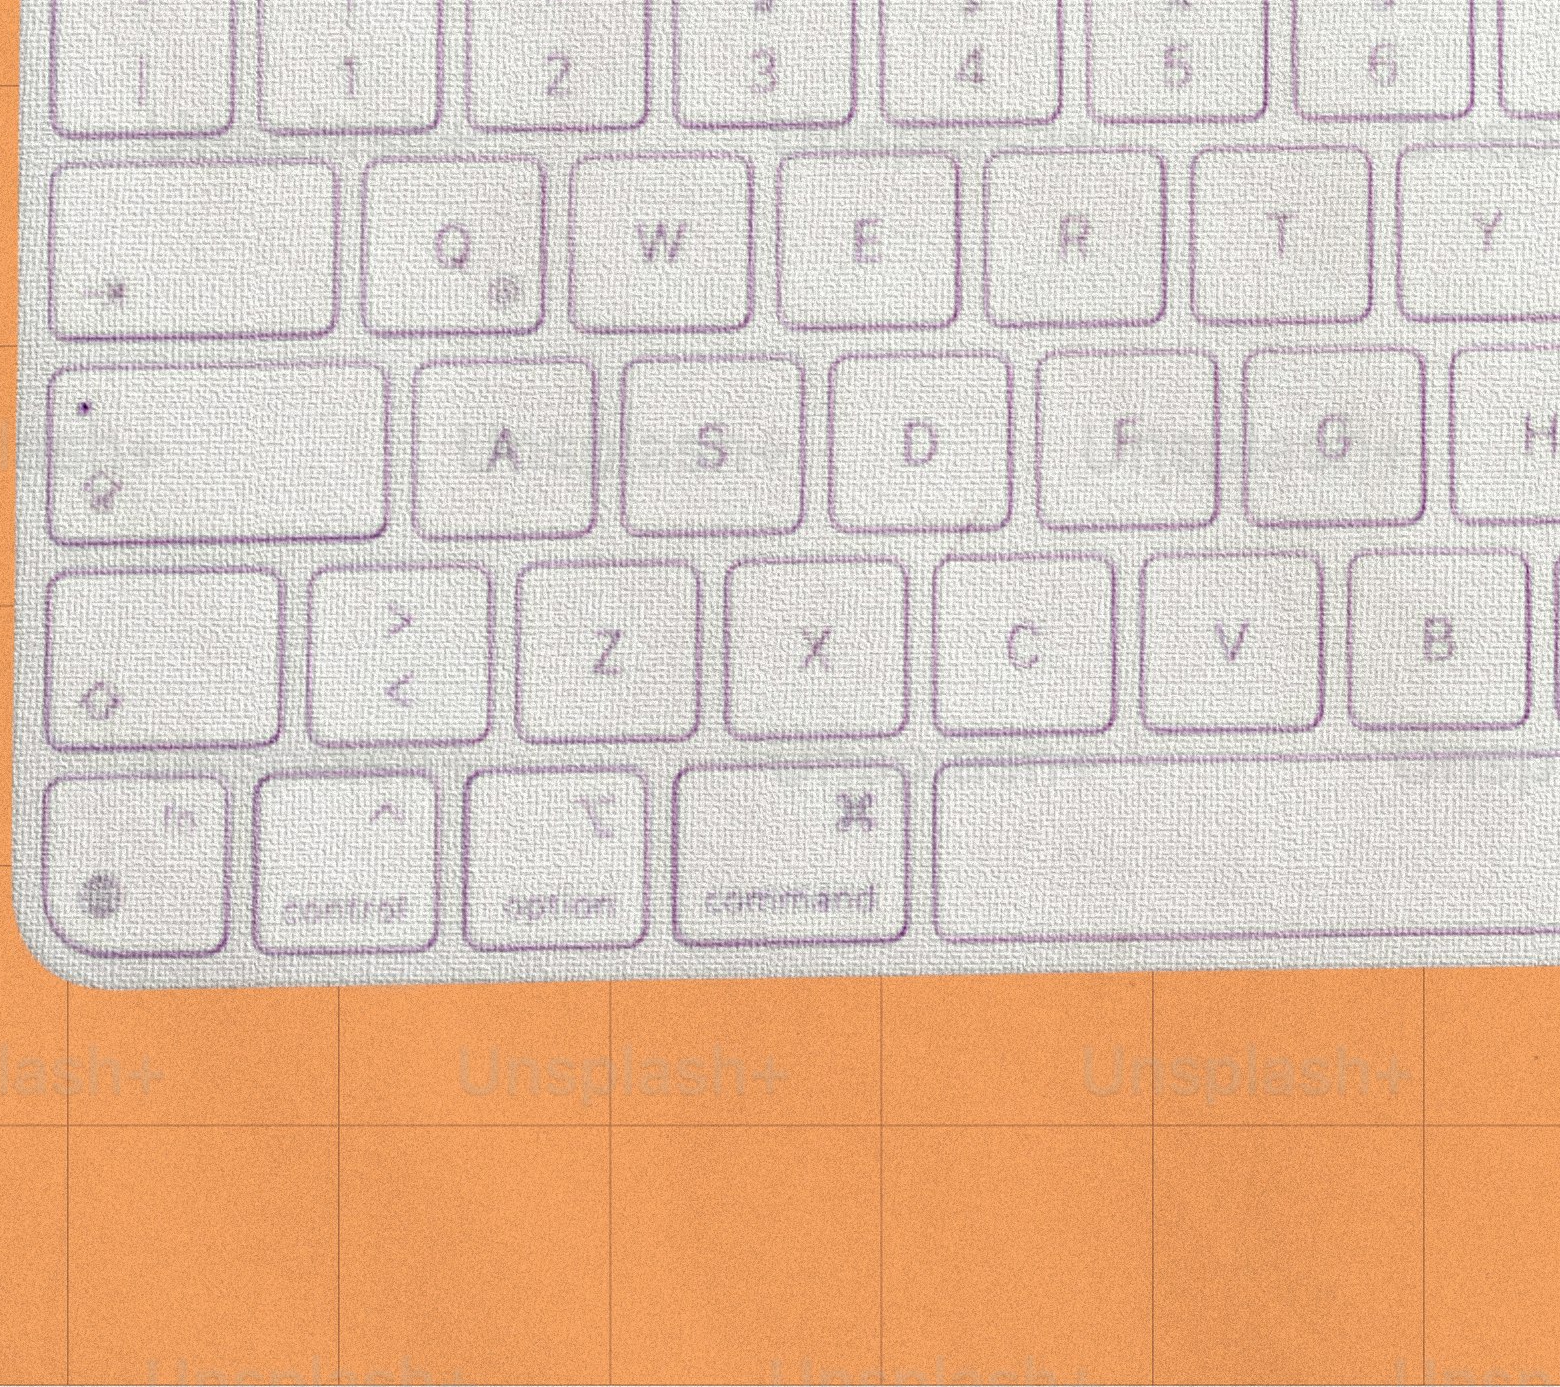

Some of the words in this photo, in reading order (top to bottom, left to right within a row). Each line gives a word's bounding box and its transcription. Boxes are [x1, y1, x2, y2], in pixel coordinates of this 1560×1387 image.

[543, 51, 574, 97] 2
[748, 47, 780, 95] 3
[954, 46, 987, 88] 4
[1162, 41, 1194, 89] 5
[1366, 41, 1400, 86] 6
[433, 221, 474, 272] Q
[634, 219, 688, 265] W
[851, 216, 882, 265] E
[1057, 213, 1094, 257] R
[1264, 209, 1296, 255] T
[1472, 208, 1504, 252] Y
[484, 425, 522, 470] A
[694, 421, 730, 471] S
[900, 419, 940, 467] D
[1113, 415, 1141, 461] F
[1314, 412, 1354, 462] G
[590, 627, 626, 679] Z
[799, 625, 834, 669] X
[1004, 619, 1042, 670] C
[1212, 619, 1252, 664] V
[1422, 616, 1457, 662] B
[282, 893, 408, 923] control
[503, 889, 617, 923] option
[704, 881, 878, 913] command
